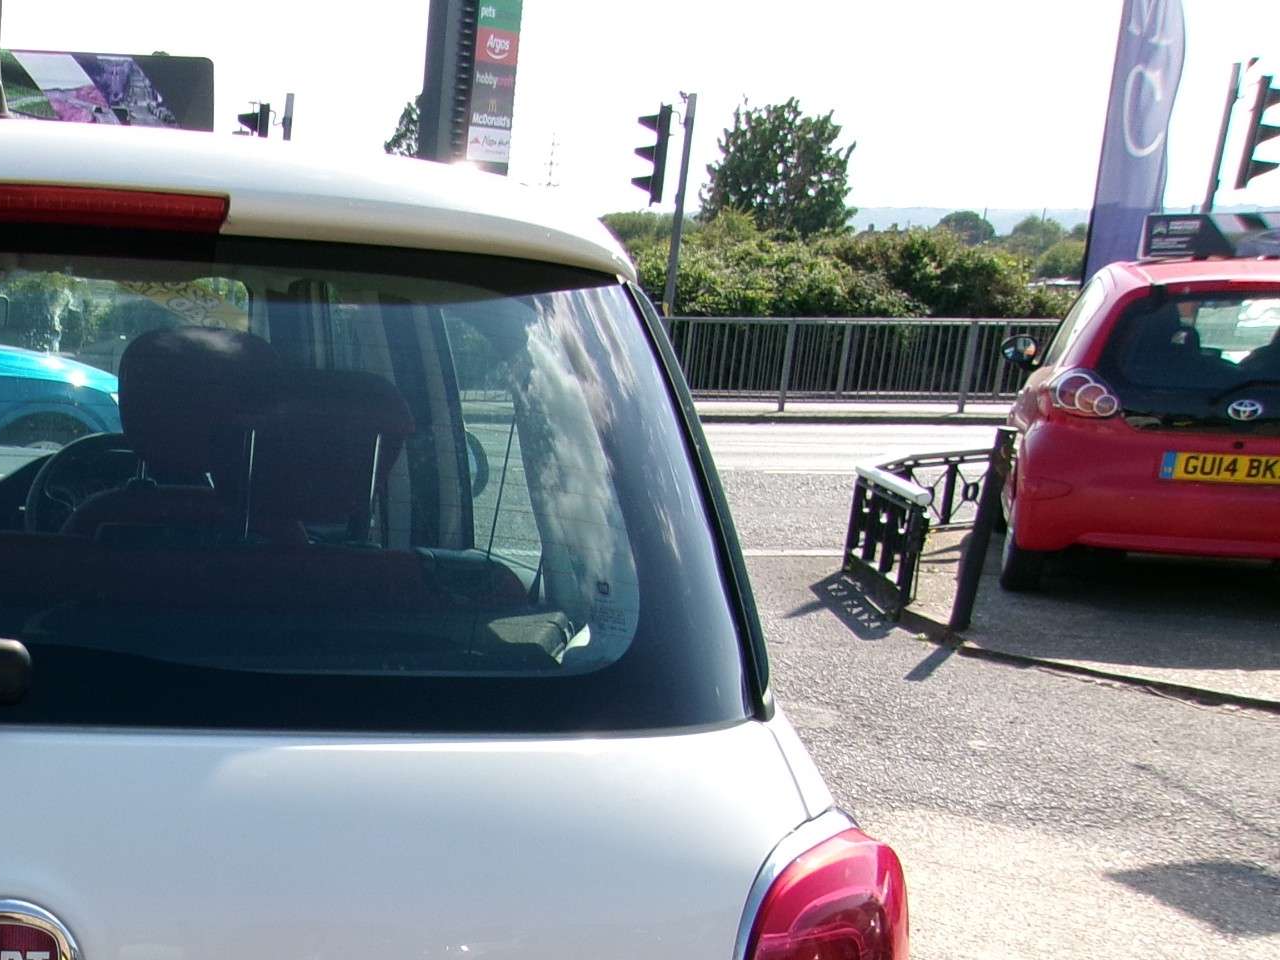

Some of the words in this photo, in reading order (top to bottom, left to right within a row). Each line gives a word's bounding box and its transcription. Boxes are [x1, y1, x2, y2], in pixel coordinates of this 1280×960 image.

[486, 33, 510, 53] Argos
[1183, 455, 1239, 477] GU14
[1245, 458, 1280, 480] BK
